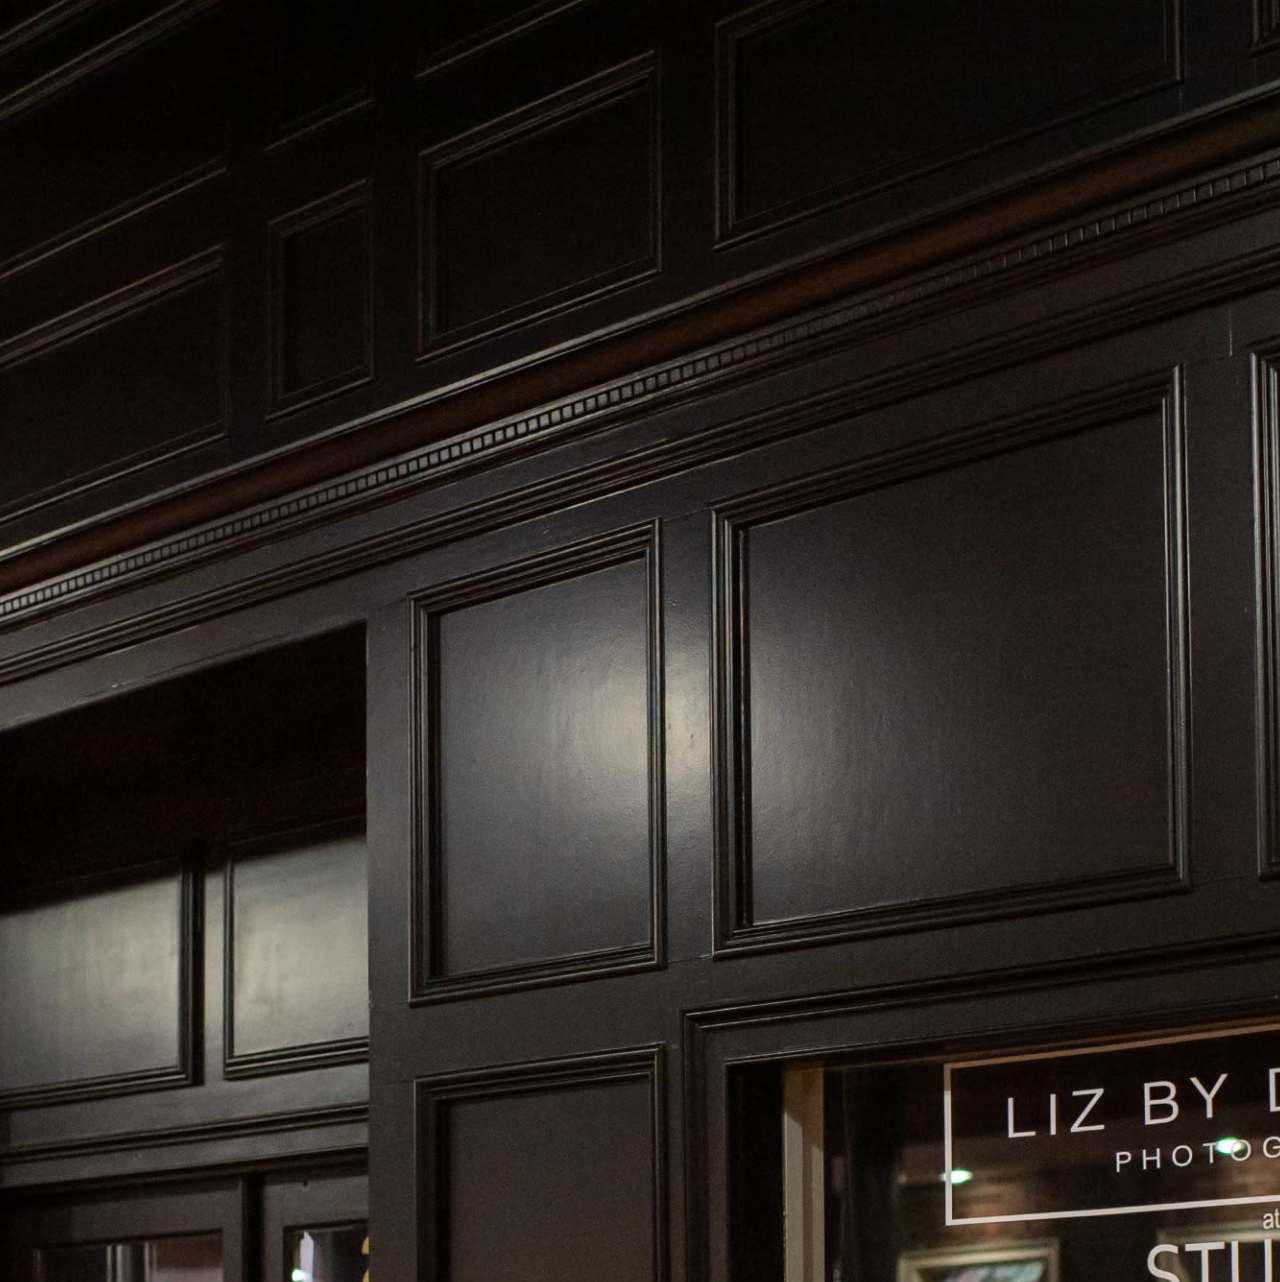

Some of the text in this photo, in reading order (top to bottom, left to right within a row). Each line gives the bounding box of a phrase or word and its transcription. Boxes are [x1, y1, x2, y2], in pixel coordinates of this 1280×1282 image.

[1006, 1088, 1106, 1138] LIZ
[1144, 1073, 1228, 1125] BY
[1262, 1208, 1280, 1229] at
